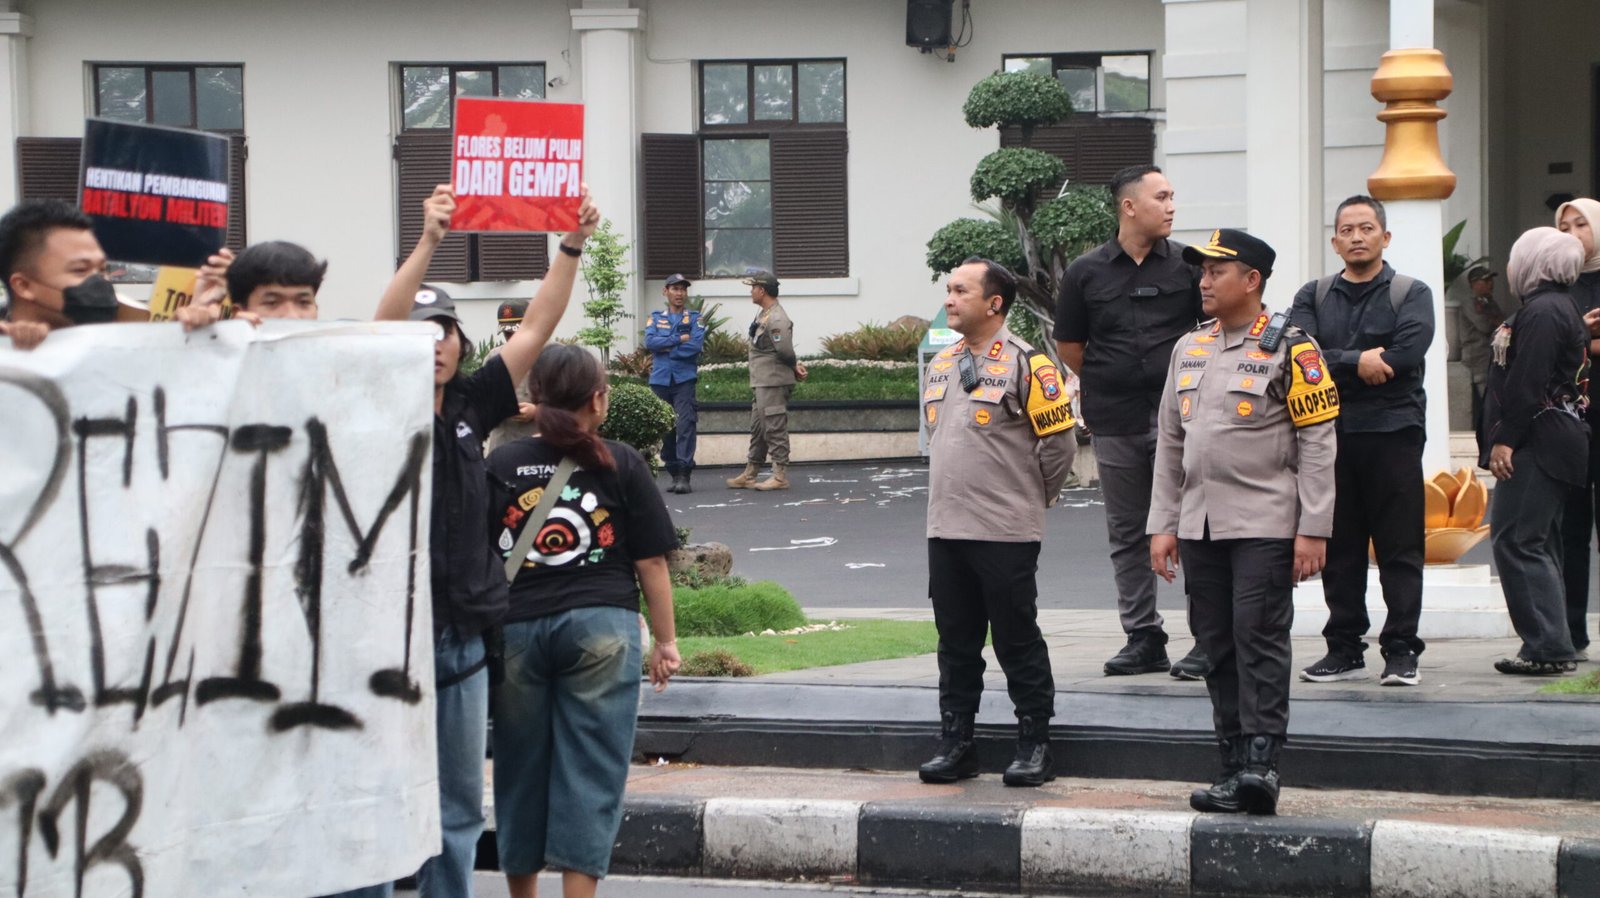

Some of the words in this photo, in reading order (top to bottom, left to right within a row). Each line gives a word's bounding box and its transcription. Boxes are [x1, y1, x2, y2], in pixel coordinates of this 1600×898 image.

[456, 135, 501, 158] FLORES
[503, 137, 547, 160] BELUM
[548, 139, 582, 161] PULIH
[85, 167, 143, 192] HENTIKAN
[455, 159, 504, 196] DARI
[508, 161, 580, 198] GEMPA
[1179, 360, 1207, 370] DANANG
[1237, 363, 1269, 375] POLRI
[929, 374, 950, 385] ALEX
[979, 376, 1007, 387] POLRI
